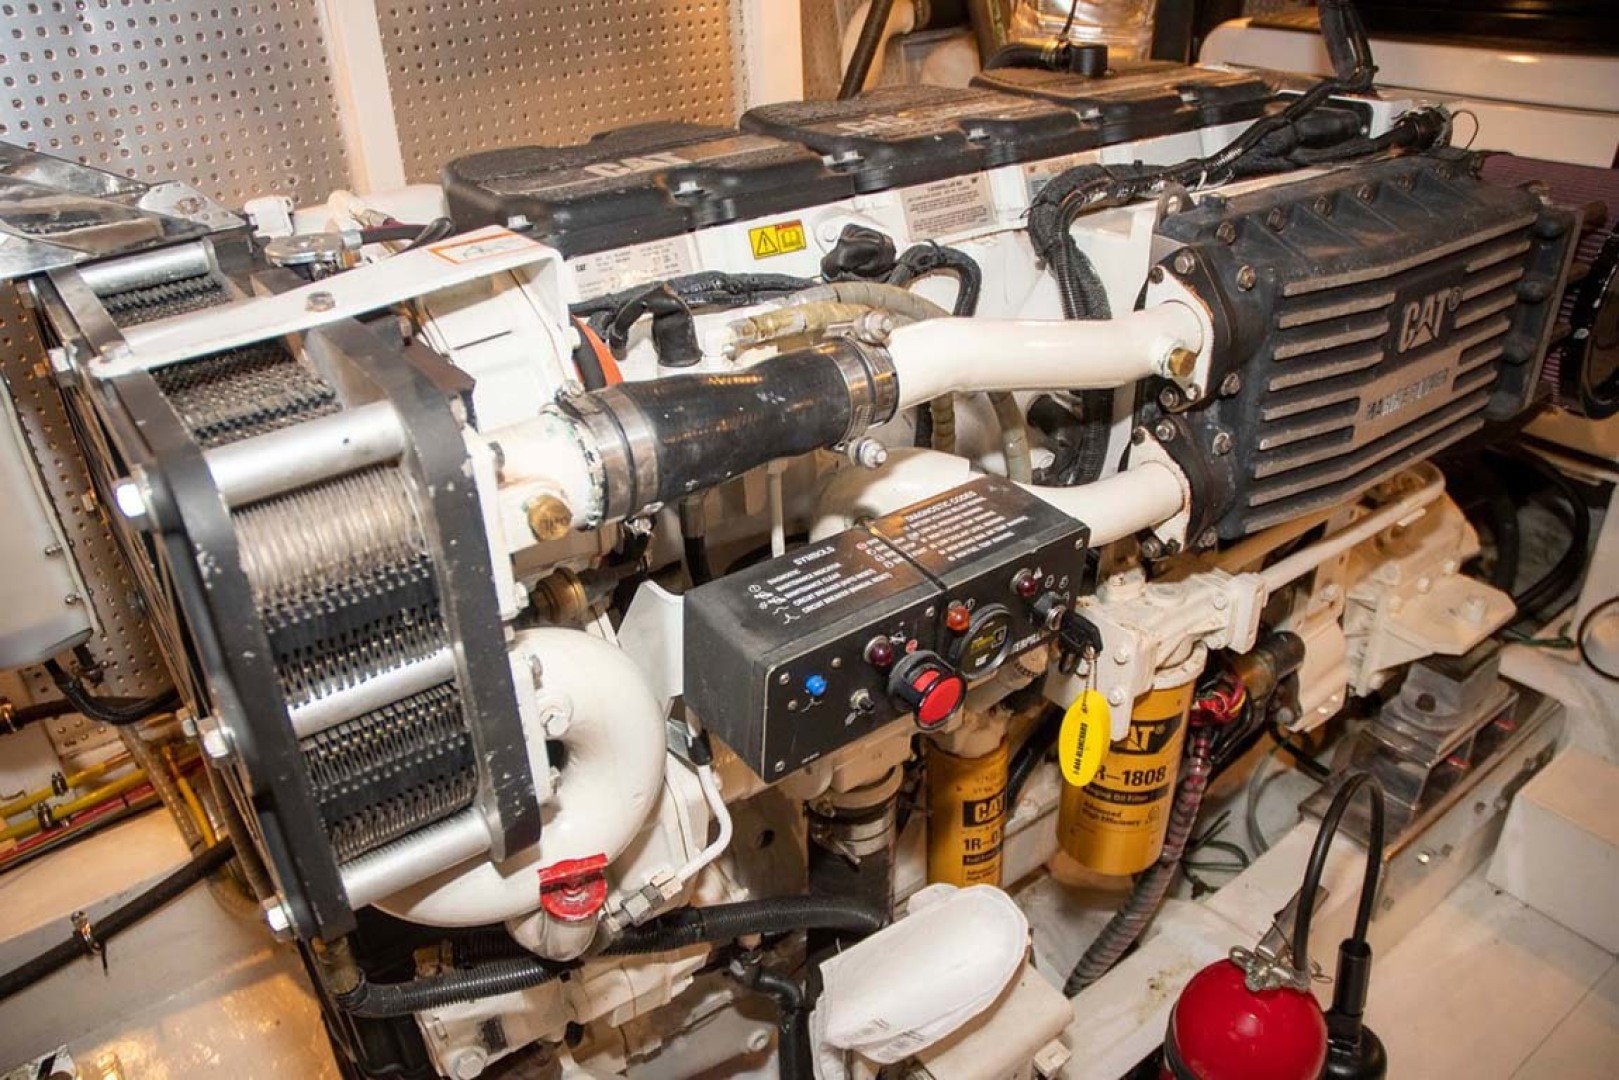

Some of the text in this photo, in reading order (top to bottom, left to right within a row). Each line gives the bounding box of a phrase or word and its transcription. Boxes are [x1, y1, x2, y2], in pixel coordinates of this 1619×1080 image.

[584, 151, 692, 178] CAT
[1398, 289, 1452, 354] CAT
[793, 546, 836, 566] SYMBOLS
[1126, 725, 1156, 751] AT
[1095, 764, 1168, 787] R-1808
